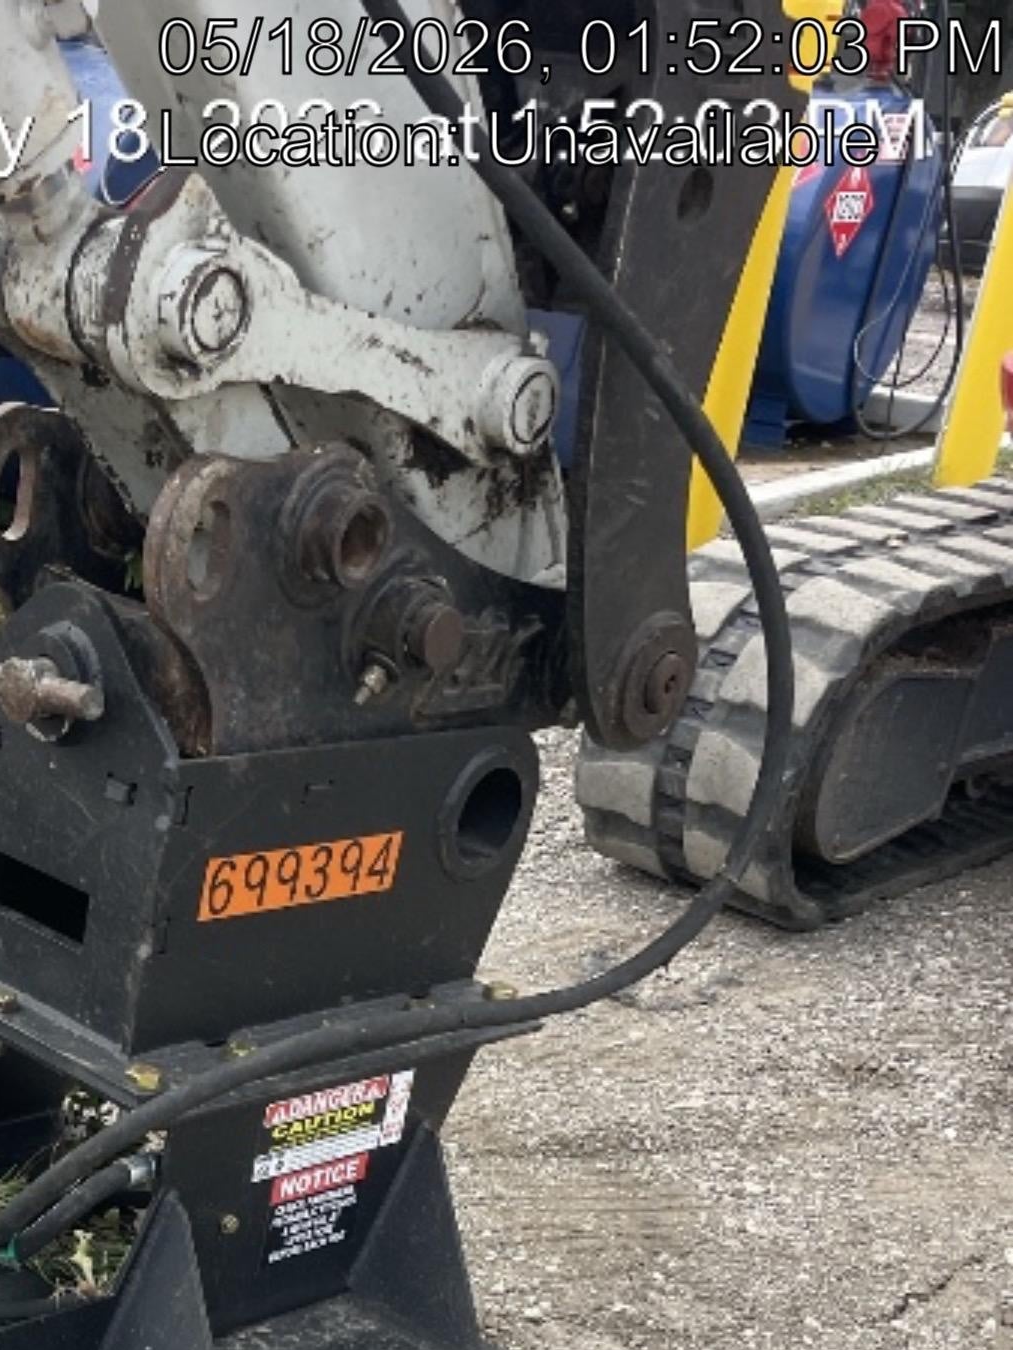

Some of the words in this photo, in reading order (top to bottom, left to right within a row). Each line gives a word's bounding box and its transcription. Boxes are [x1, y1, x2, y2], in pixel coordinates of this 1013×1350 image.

[208, 837, 393, 915] 699394
[289, 1082, 368, 1119] DANGER
[272, 1102, 375, 1138] CAUTION
[280, 1160, 358, 1198] NOTICE
